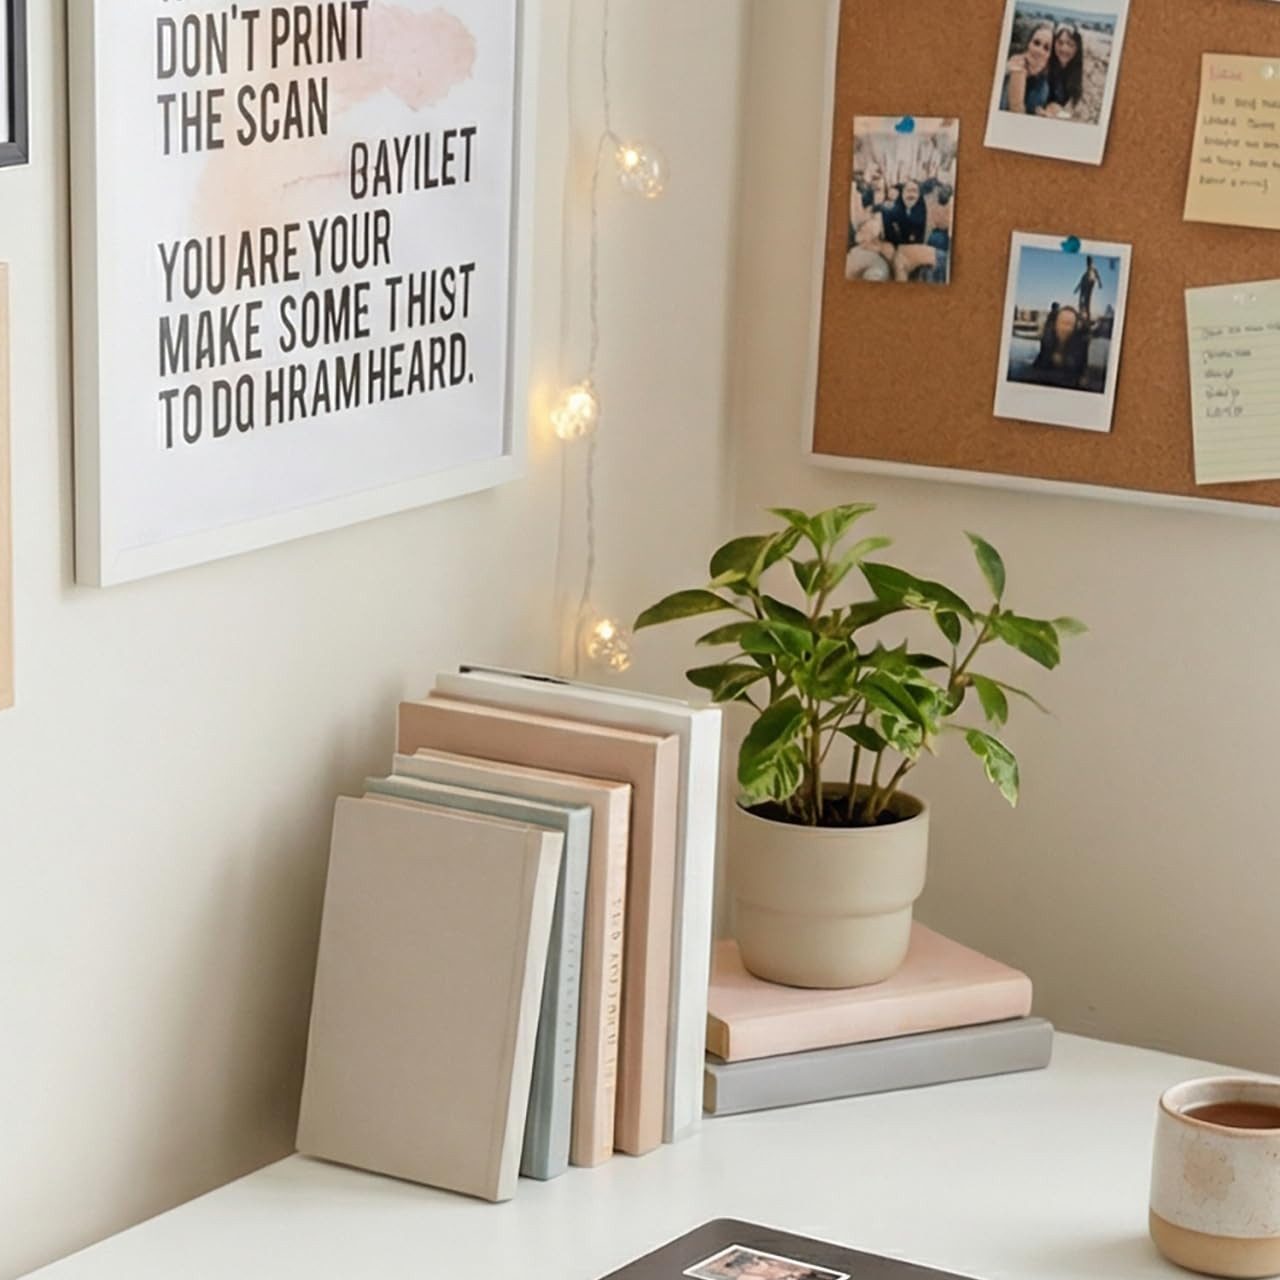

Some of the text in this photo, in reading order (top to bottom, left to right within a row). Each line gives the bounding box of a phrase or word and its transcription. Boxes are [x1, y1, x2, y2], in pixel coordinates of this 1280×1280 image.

[157, 0, 369, 79] DON'T PRINT
[157, 76, 328, 155] THE SCAN
[158, 208, 391, 302] YOU ARE YOUR
[159, 262, 476, 377] MAKE SOME THIST
[158, 384, 202, 449] TO
